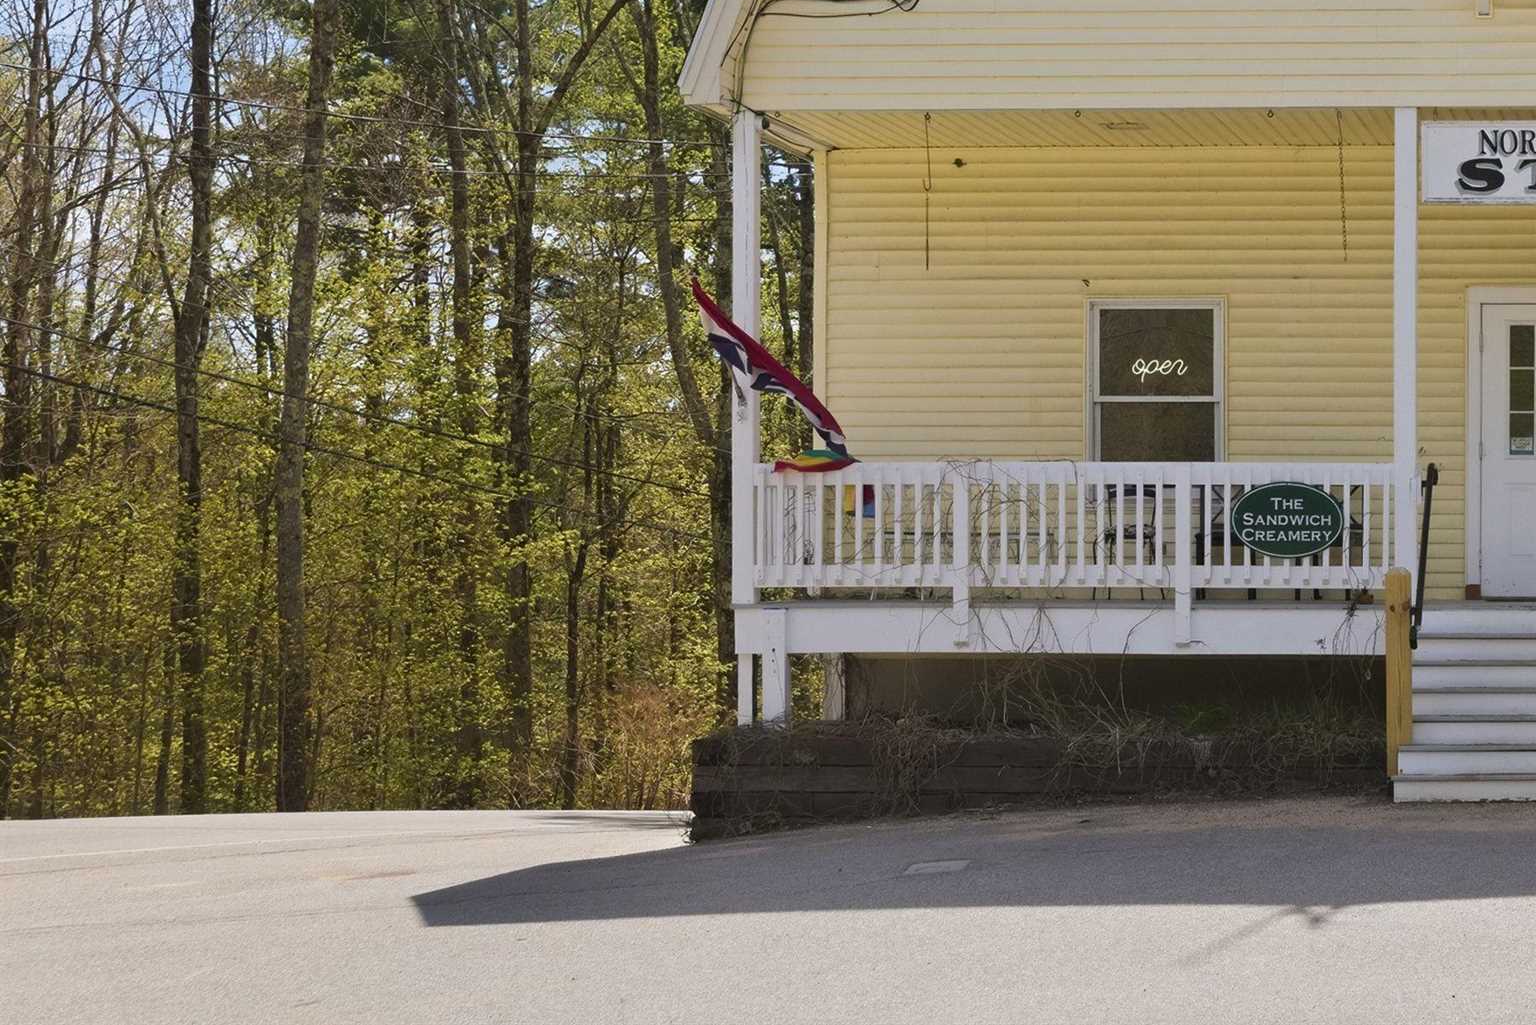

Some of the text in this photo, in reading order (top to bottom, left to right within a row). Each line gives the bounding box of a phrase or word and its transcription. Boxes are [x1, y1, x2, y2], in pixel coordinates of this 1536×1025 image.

[1131, 358, 1189, 383] open
[1270, 497, 1304, 511] THE
[1242, 512, 1332, 526] SANDWICH
[1241, 528, 1333, 543] CREAMERY
